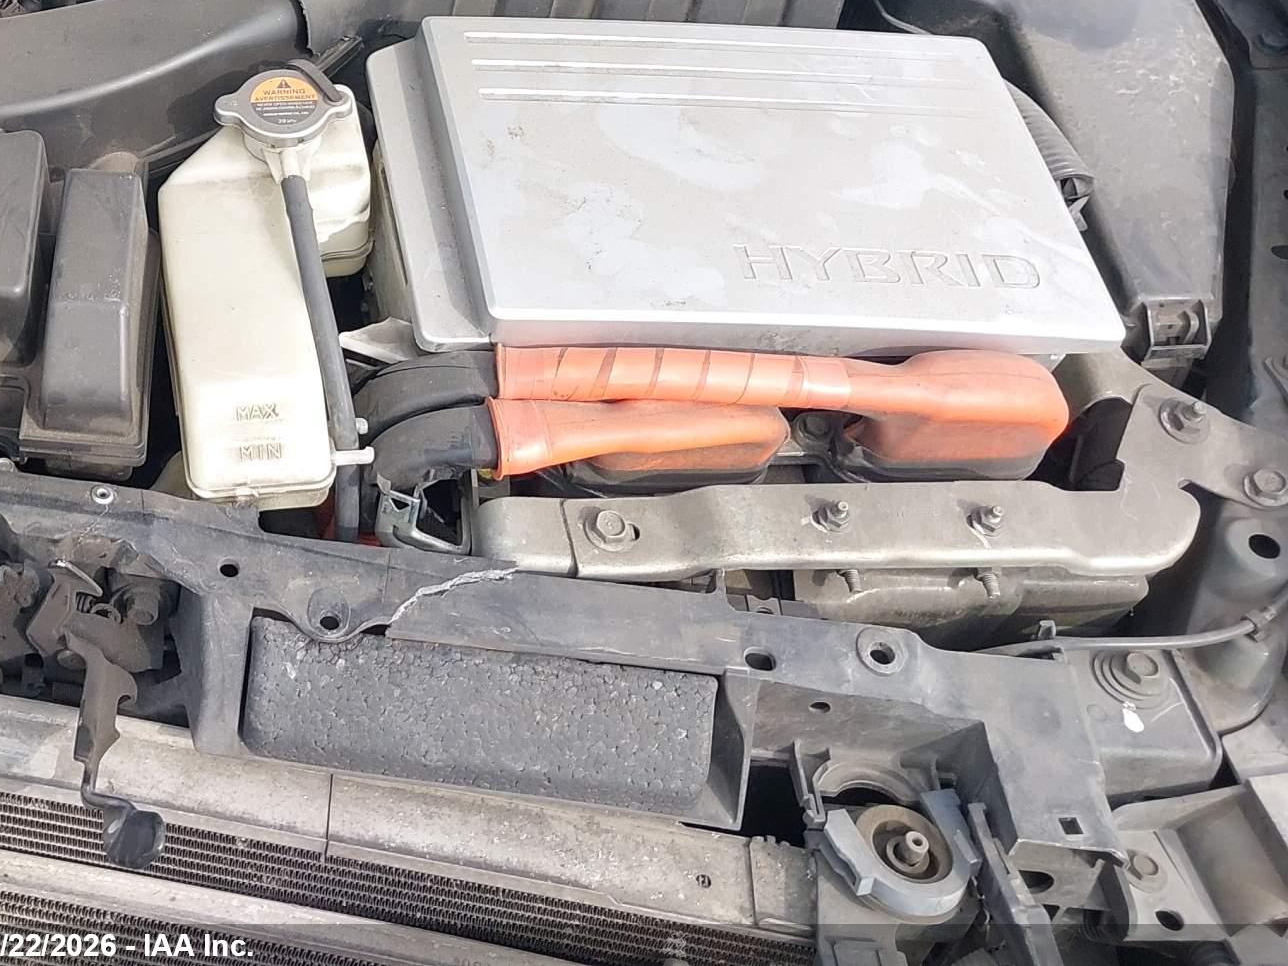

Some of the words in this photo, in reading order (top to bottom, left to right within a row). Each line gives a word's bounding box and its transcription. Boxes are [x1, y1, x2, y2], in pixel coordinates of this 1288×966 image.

[263, 88, 306, 96] WARNING
[733, 243, 1041, 289] HYBRID
[233, 403, 279, 421] MAX
[239, 443, 282, 461] MIN
